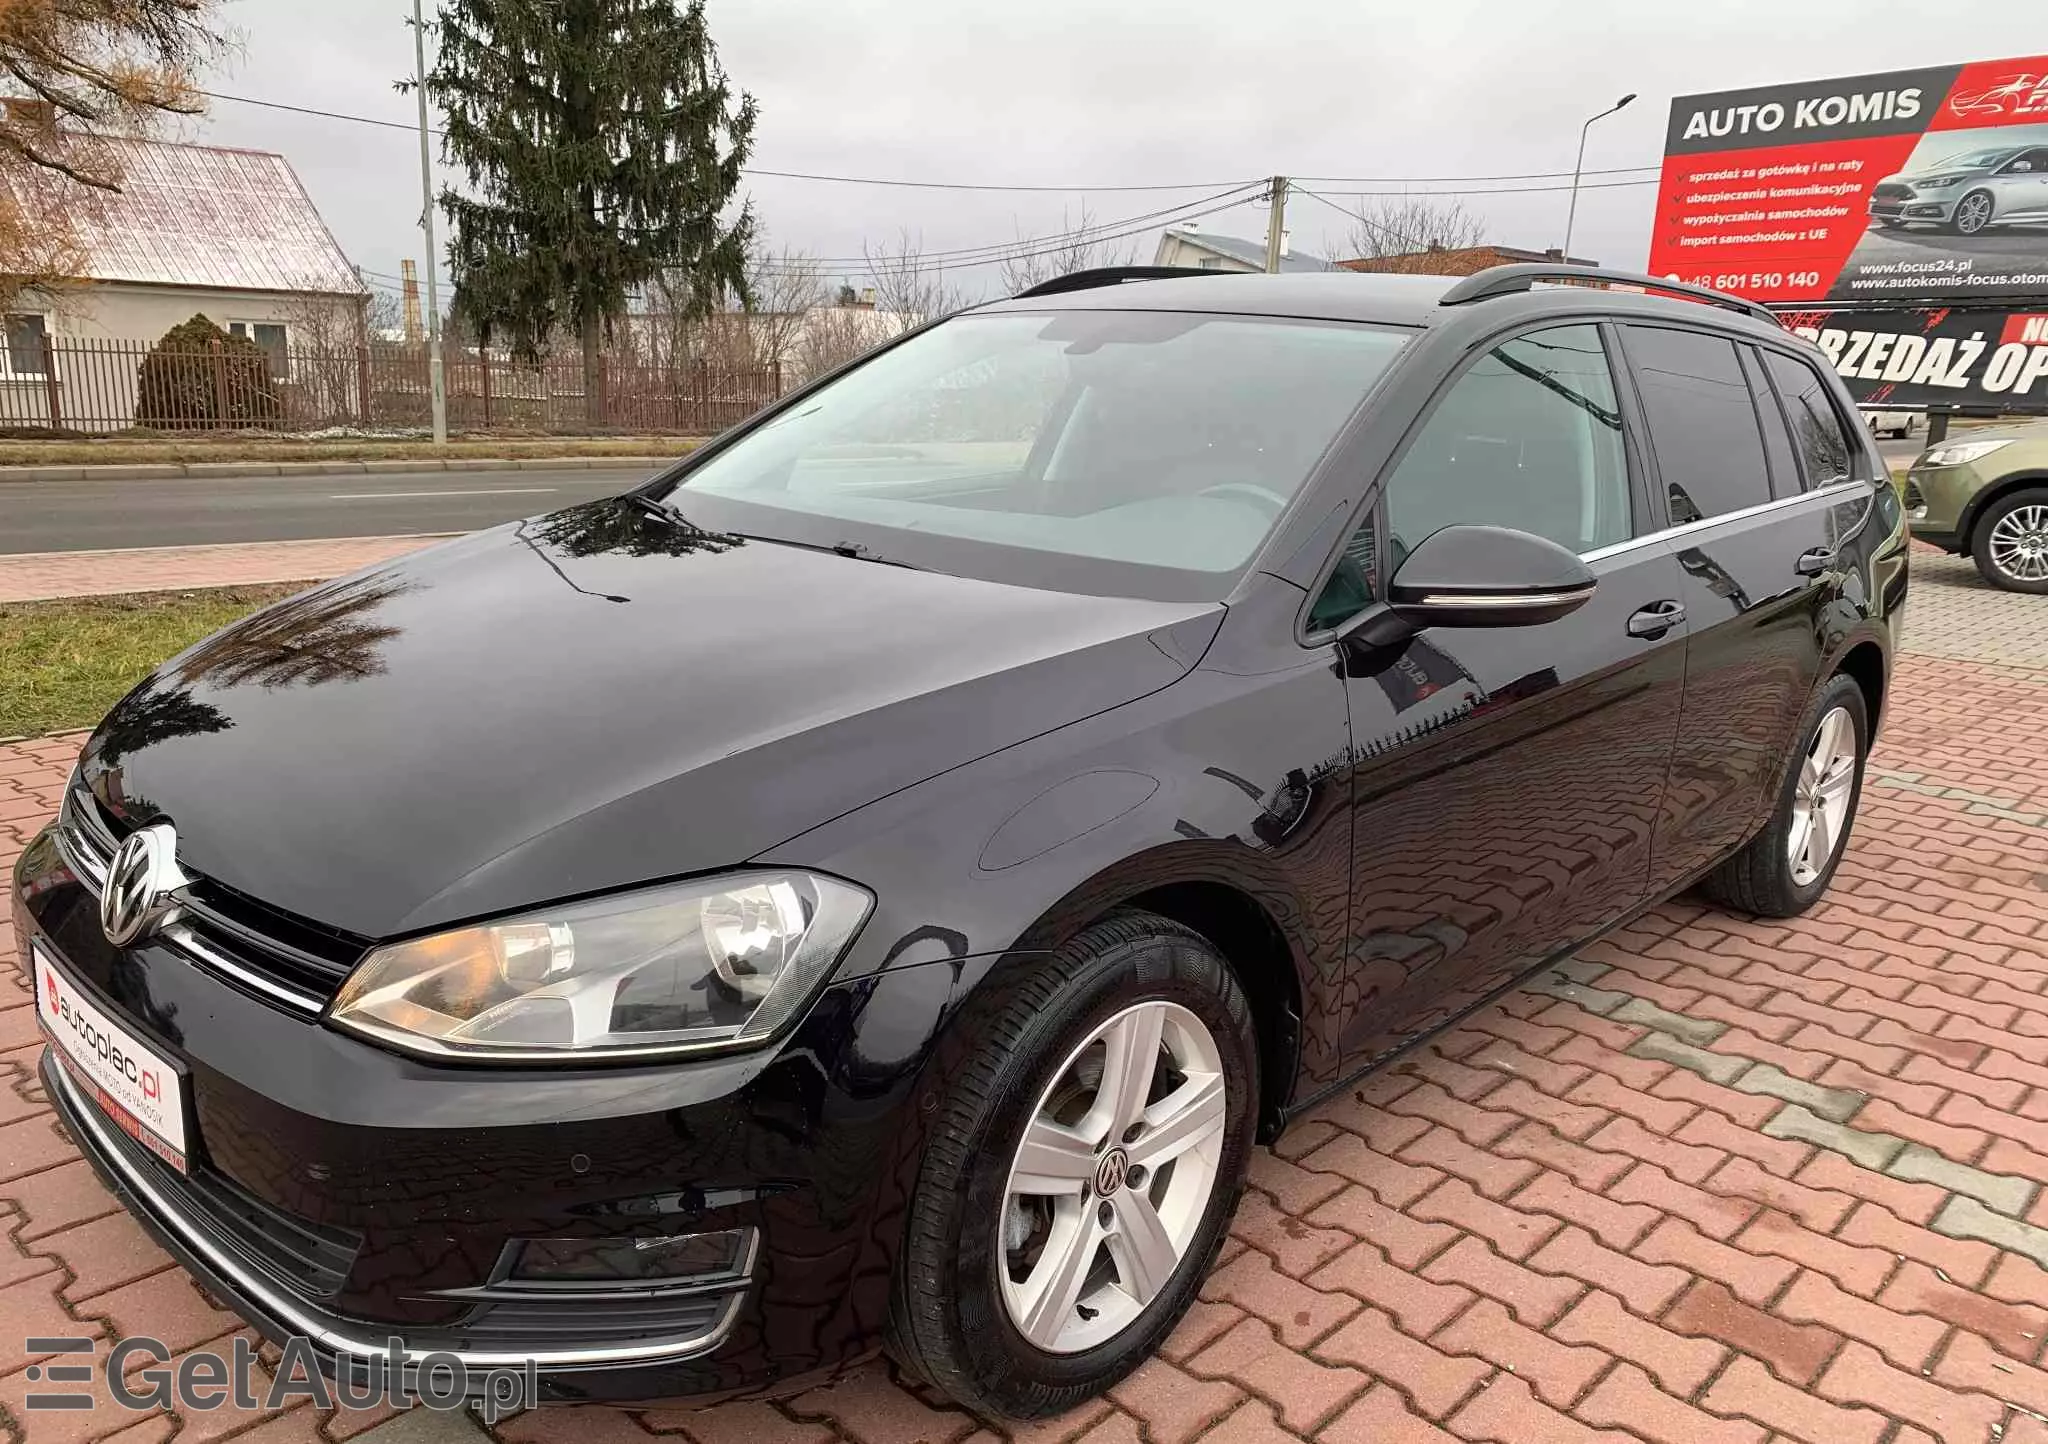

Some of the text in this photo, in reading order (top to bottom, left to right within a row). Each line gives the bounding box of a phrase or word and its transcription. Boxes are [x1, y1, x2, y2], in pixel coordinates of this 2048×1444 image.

[1682, 88, 1923, 140] AUTO KOMIS
[1689, 167, 1740, 184] sprzedaż
[1742, 168, 1756, 178] za
[1758, 163, 1809, 179] gotówkę
[1819, 162, 1836, 172] na
[1838, 160, 1864, 172] raty
[1686, 182, 1862, 205] ubezpieczenia komunikacyjne
[1683, 206, 1849, 227] wypożyczalnia samochodów
[1680, 228, 1829, 248] import samochodów z UE
[1859, 259, 1973, 275] www.focus24.pl
[1715, 274, 1746, 289] 601
[1750, 272, 1782, 288] 510
[1787, 271, 1820, 288] 140
[61, 996, 161, 1103] autoplac.pl
